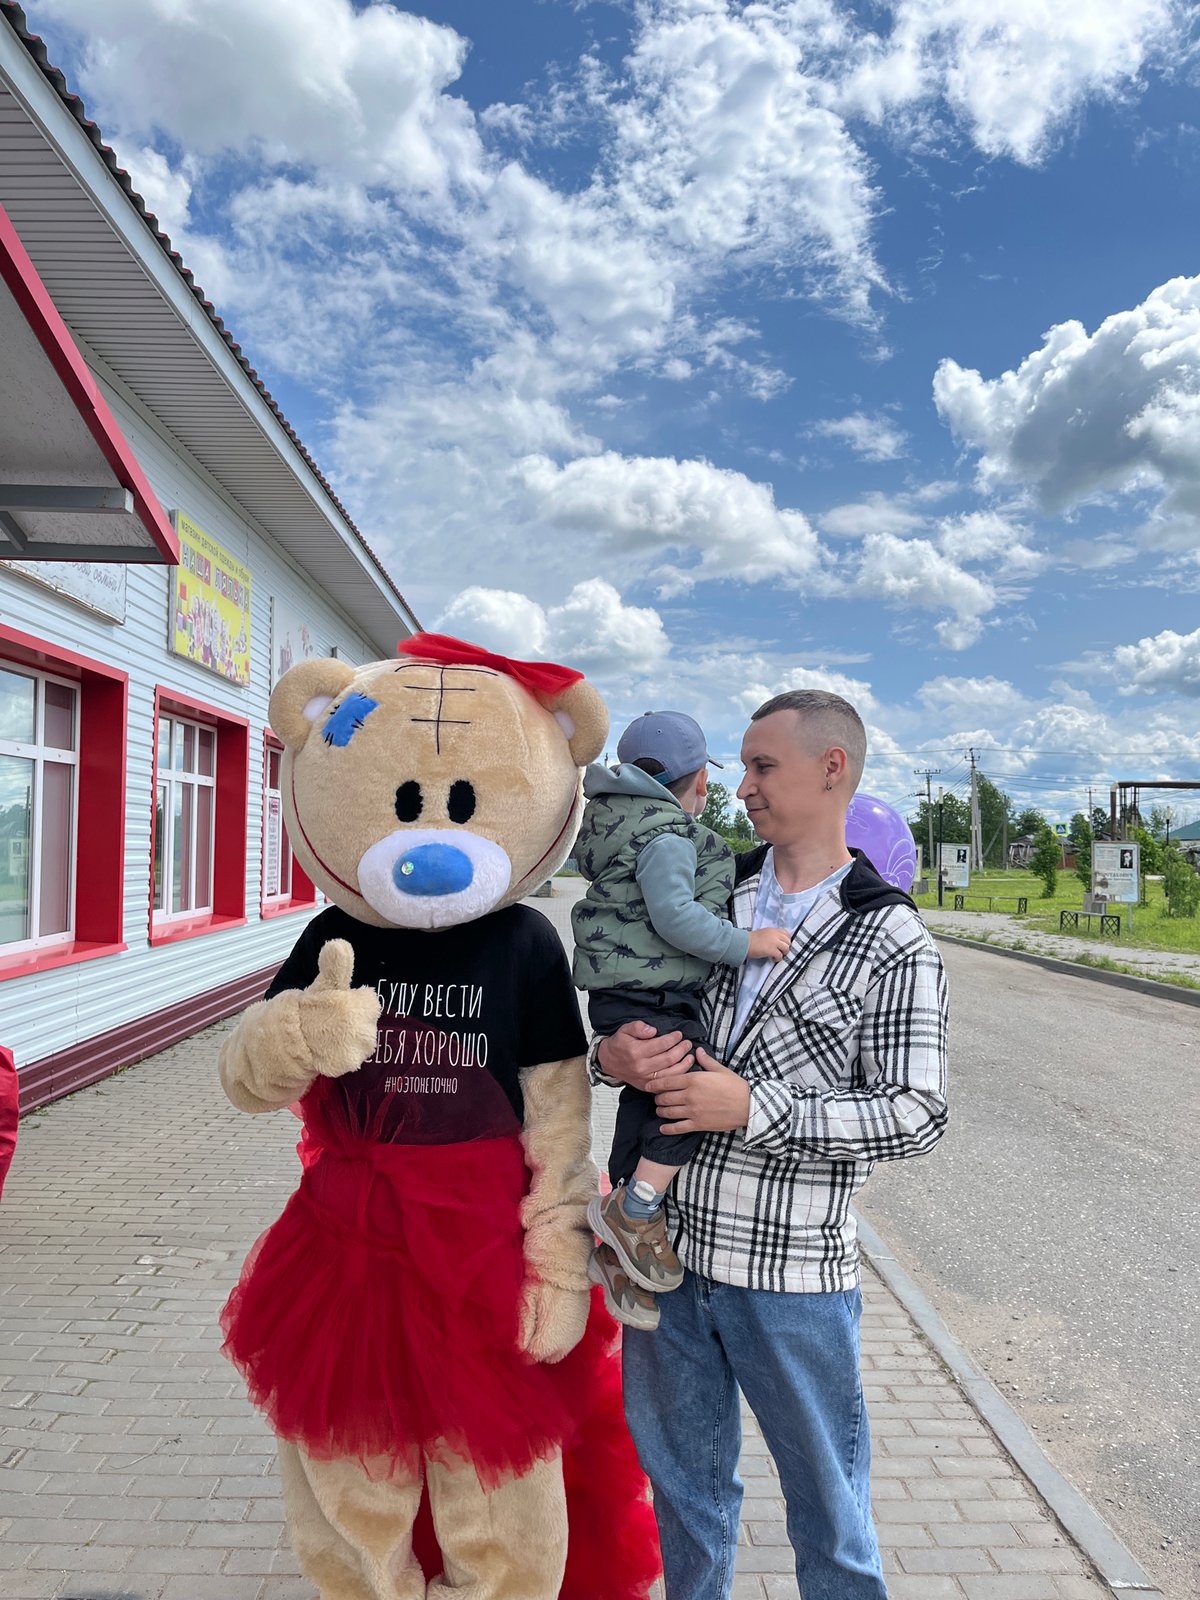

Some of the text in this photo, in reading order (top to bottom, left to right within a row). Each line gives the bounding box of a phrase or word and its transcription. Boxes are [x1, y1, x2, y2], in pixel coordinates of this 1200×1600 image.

[181, 541, 250, 614] НАША ЛЯЛЬКА
[377, 978, 483, 1019] БУДУ ВЕСТИ
[365, 1029, 488, 1068] ЕБЯ ХОРОШО
[384, 1076, 458, 1094] #НОЭТОНЕТОЧНО
